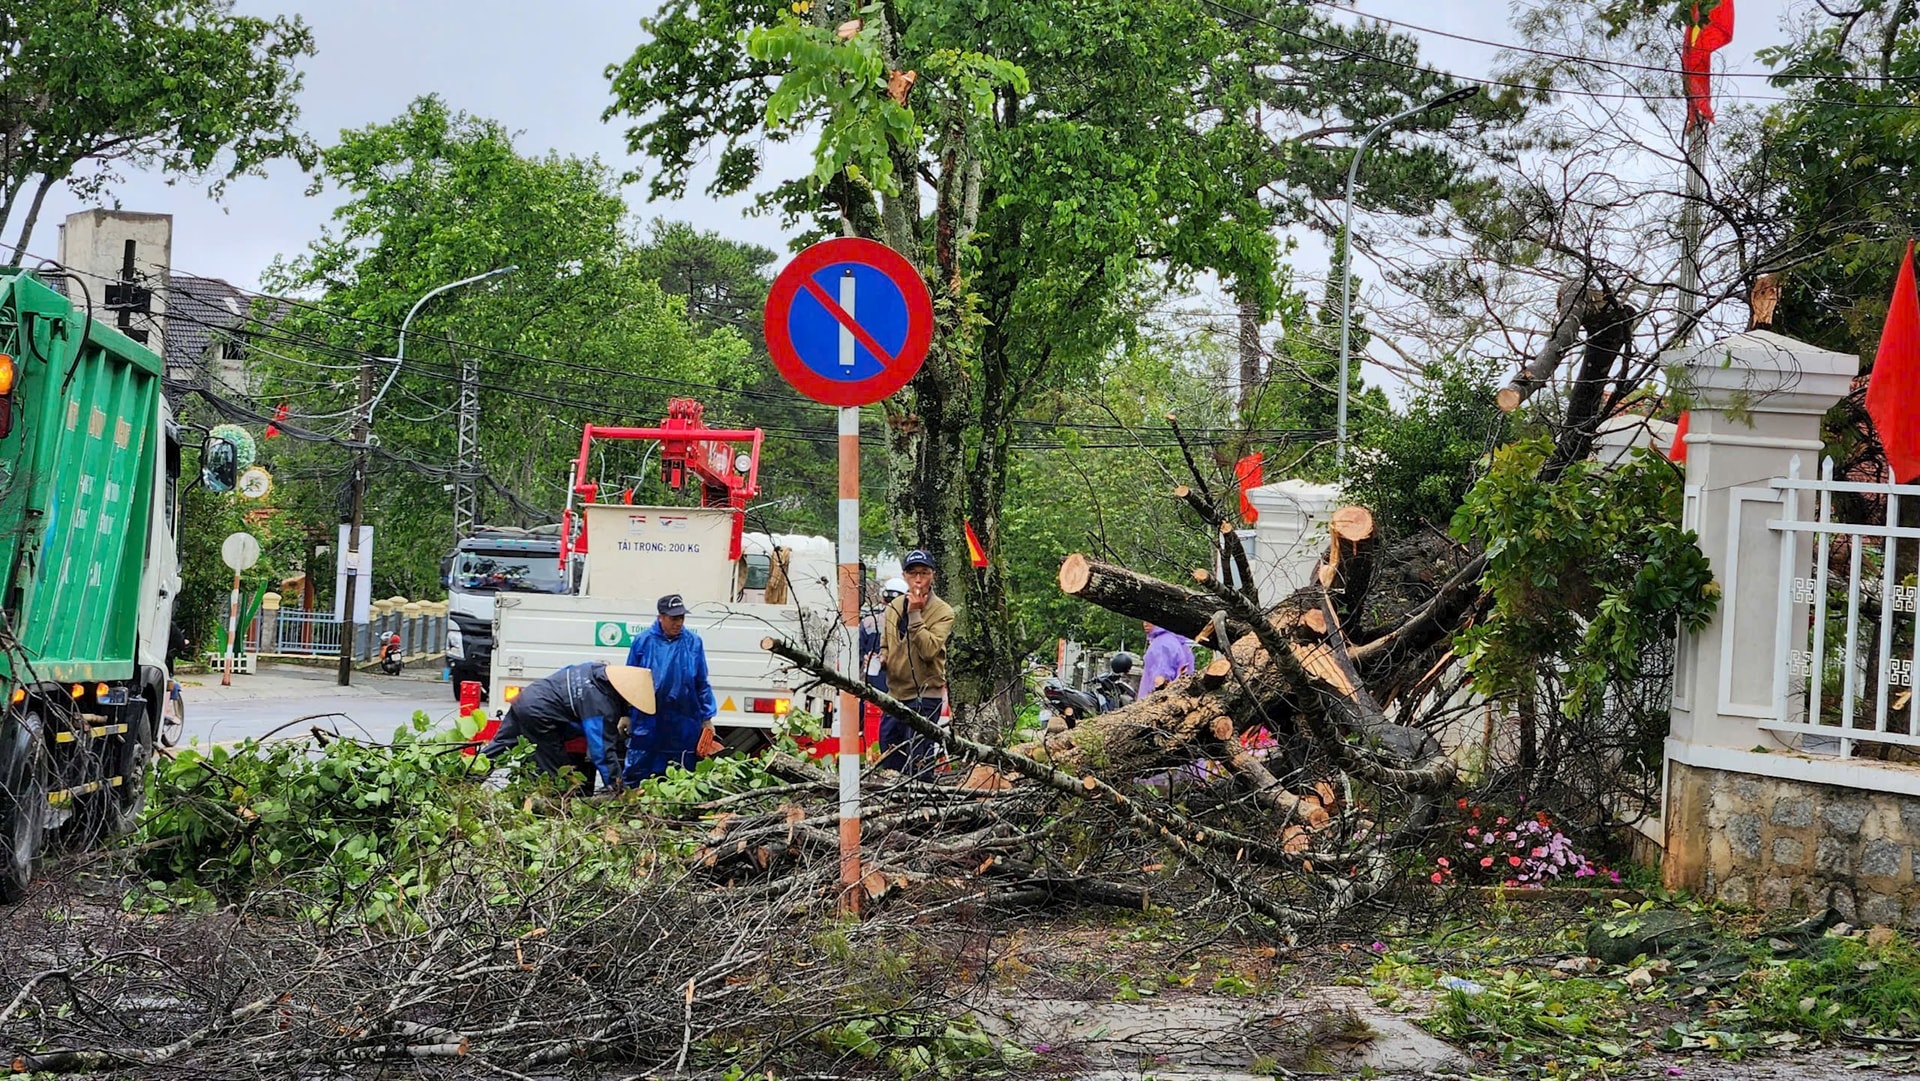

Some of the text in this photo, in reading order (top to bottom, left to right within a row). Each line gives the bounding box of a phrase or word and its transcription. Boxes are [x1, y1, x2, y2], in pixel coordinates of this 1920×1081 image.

[617, 539, 700, 553] TẢI TRỌNG: 200 KG
